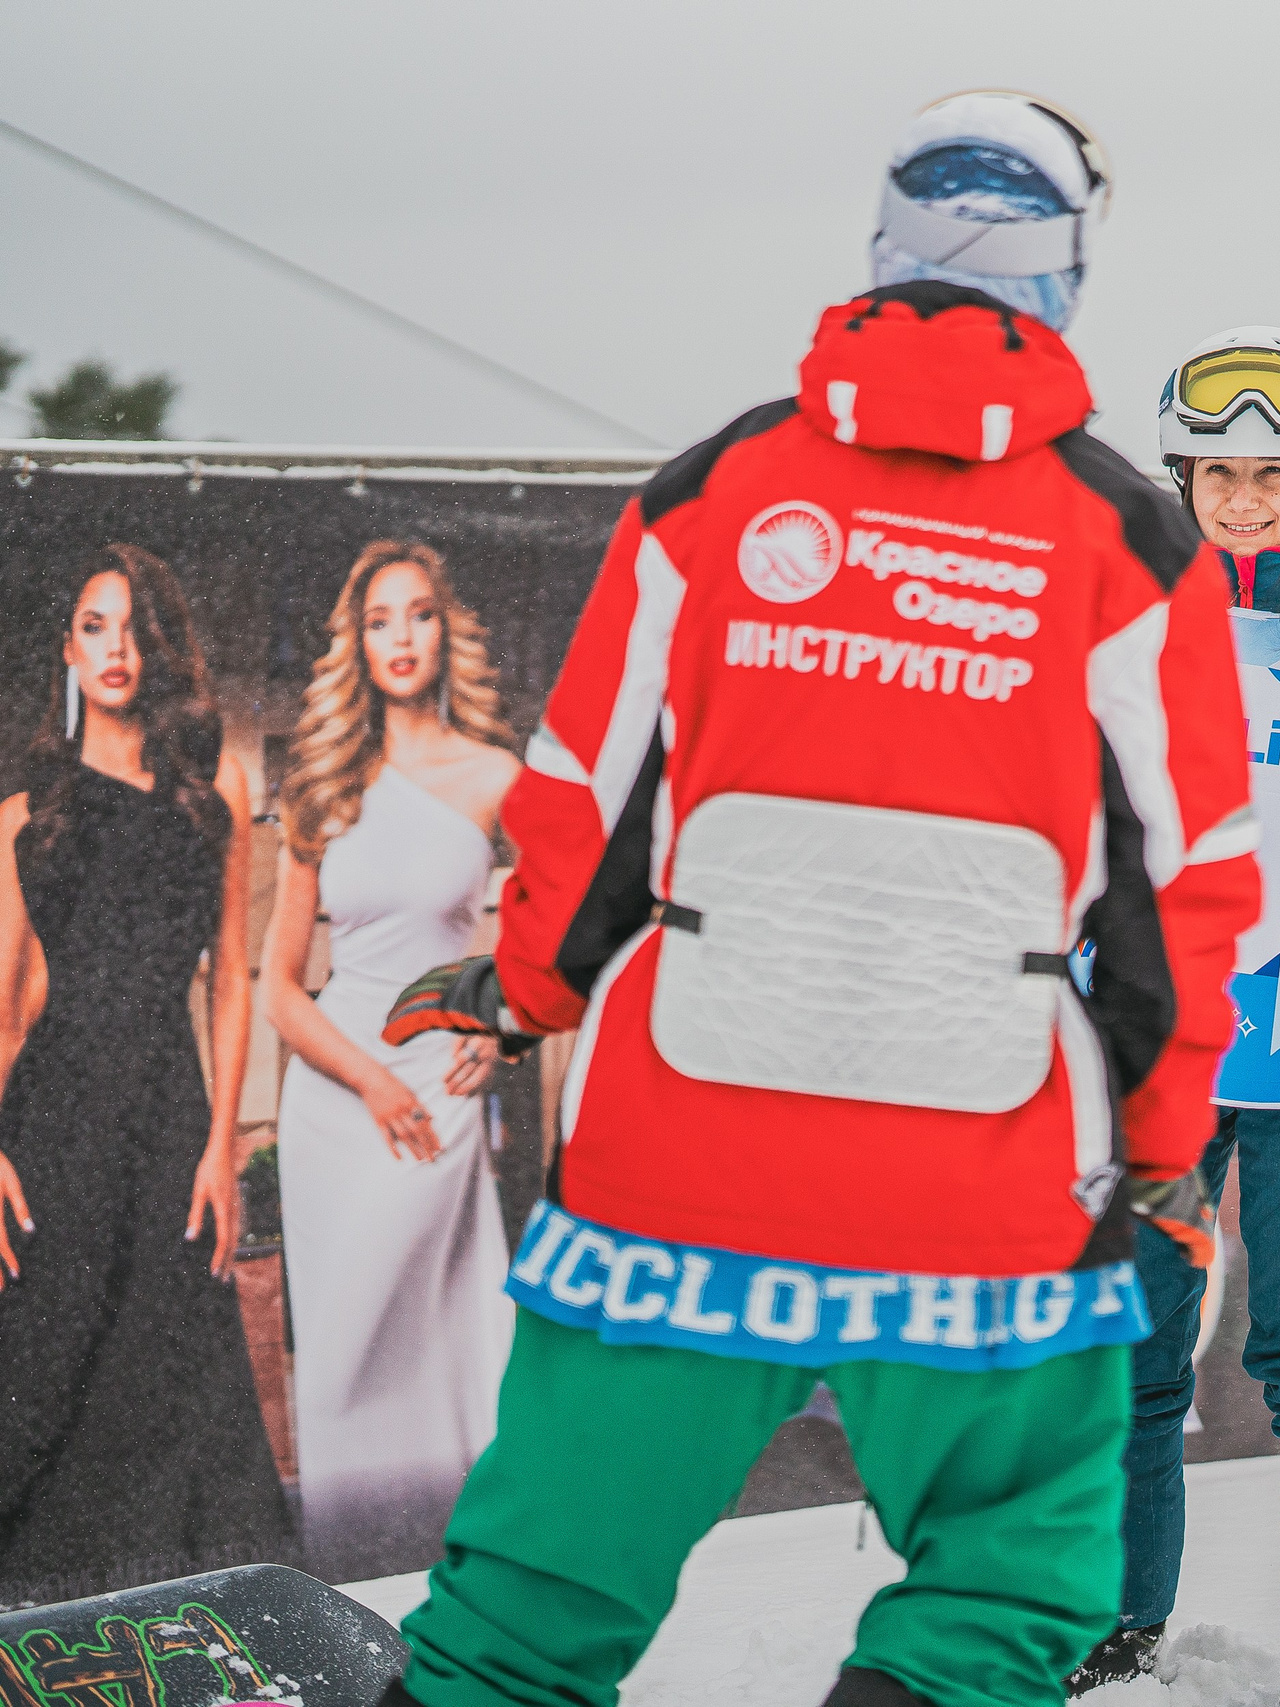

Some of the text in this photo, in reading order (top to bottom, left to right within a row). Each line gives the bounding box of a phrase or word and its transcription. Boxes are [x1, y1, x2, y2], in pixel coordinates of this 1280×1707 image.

[846, 530, 1047, 597] Красное
[893, 580, 1040, 642] Озеро
[725, 620, 1034, 702] ИНСТРУКТОР
